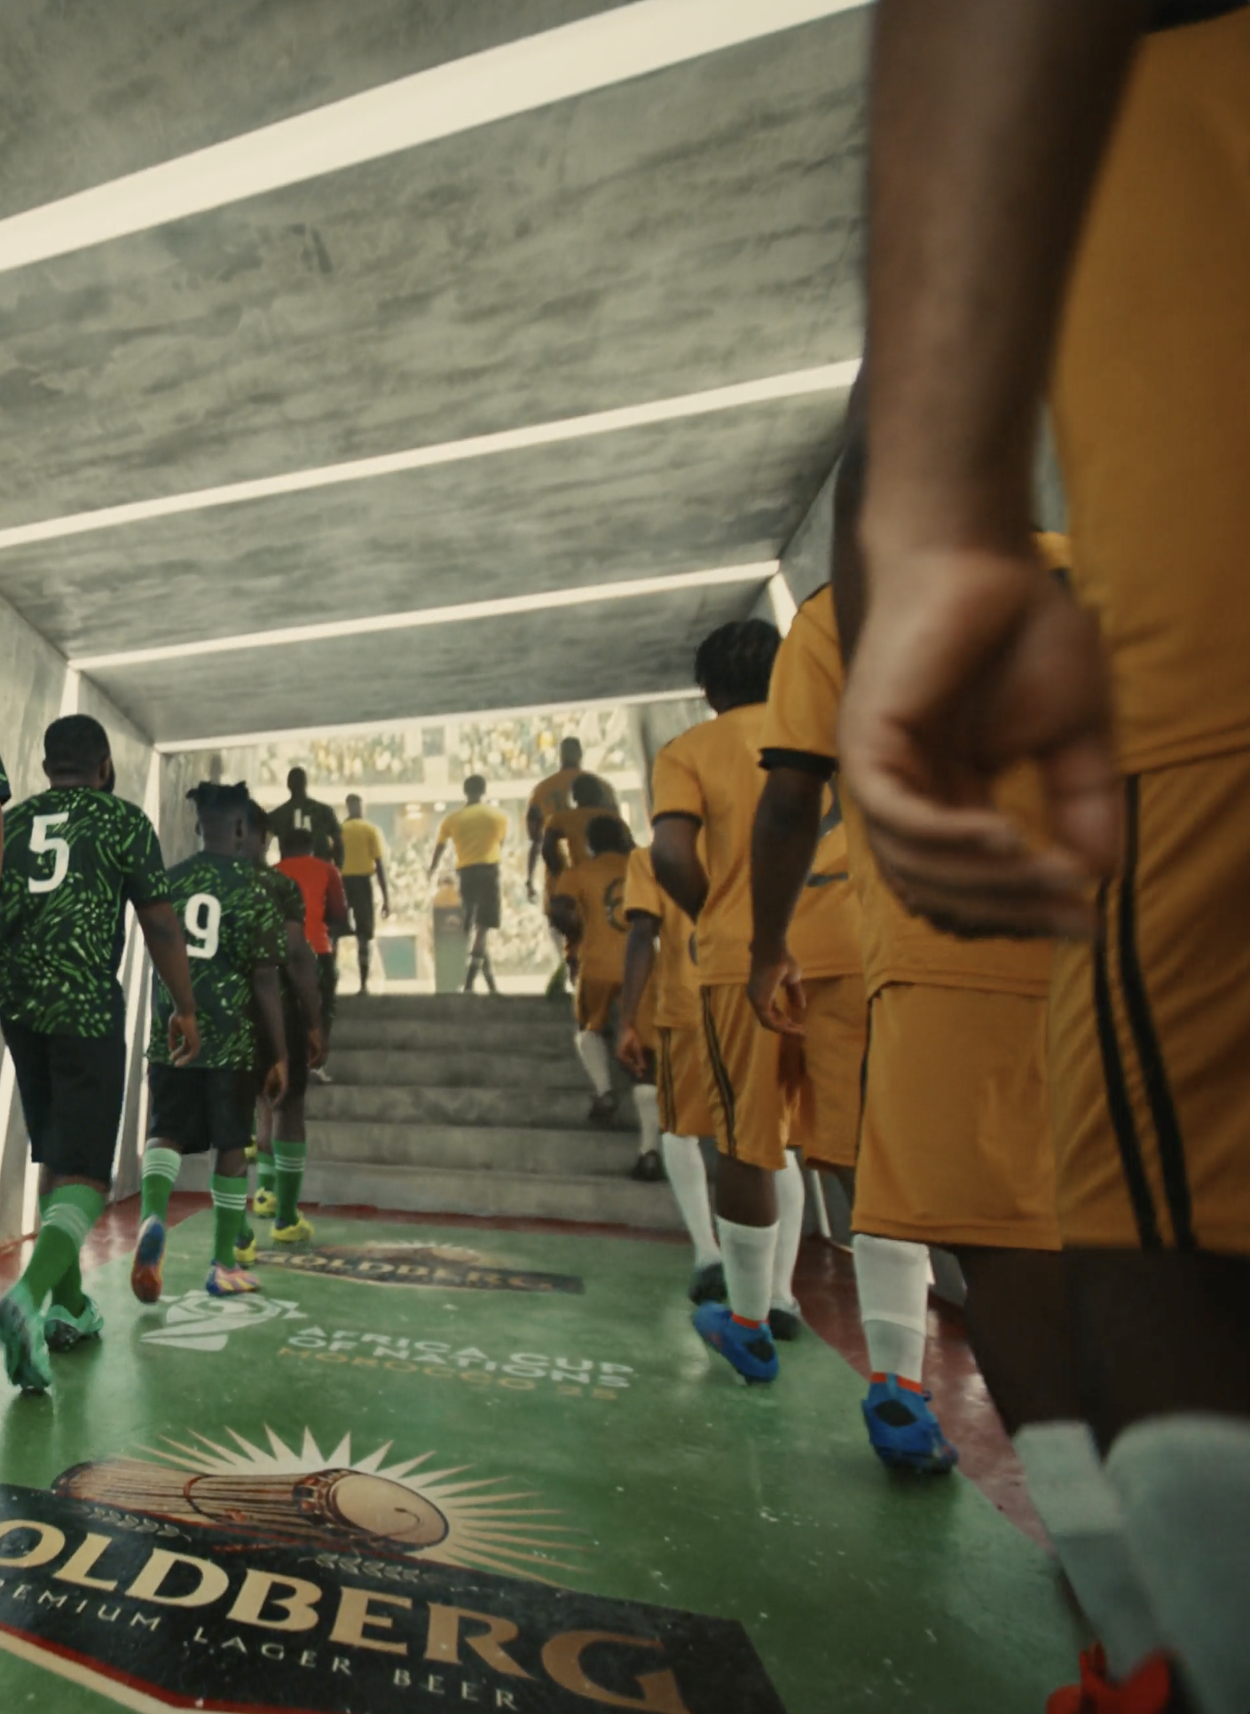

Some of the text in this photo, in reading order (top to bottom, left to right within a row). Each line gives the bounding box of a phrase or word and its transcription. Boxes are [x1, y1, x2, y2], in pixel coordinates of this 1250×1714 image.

[27, 811, 70, 894] 5
[183, 893, 222, 960] 9
[277, 1346, 536, 1391] MOROCCO
[287, 1336, 631, 1389] OF NATIONS
[297, 1325, 635, 1375] AFRICA CUP
[193, 1626, 353, 1676] LAGER
[392, 1668, 519, 1712] BEER
